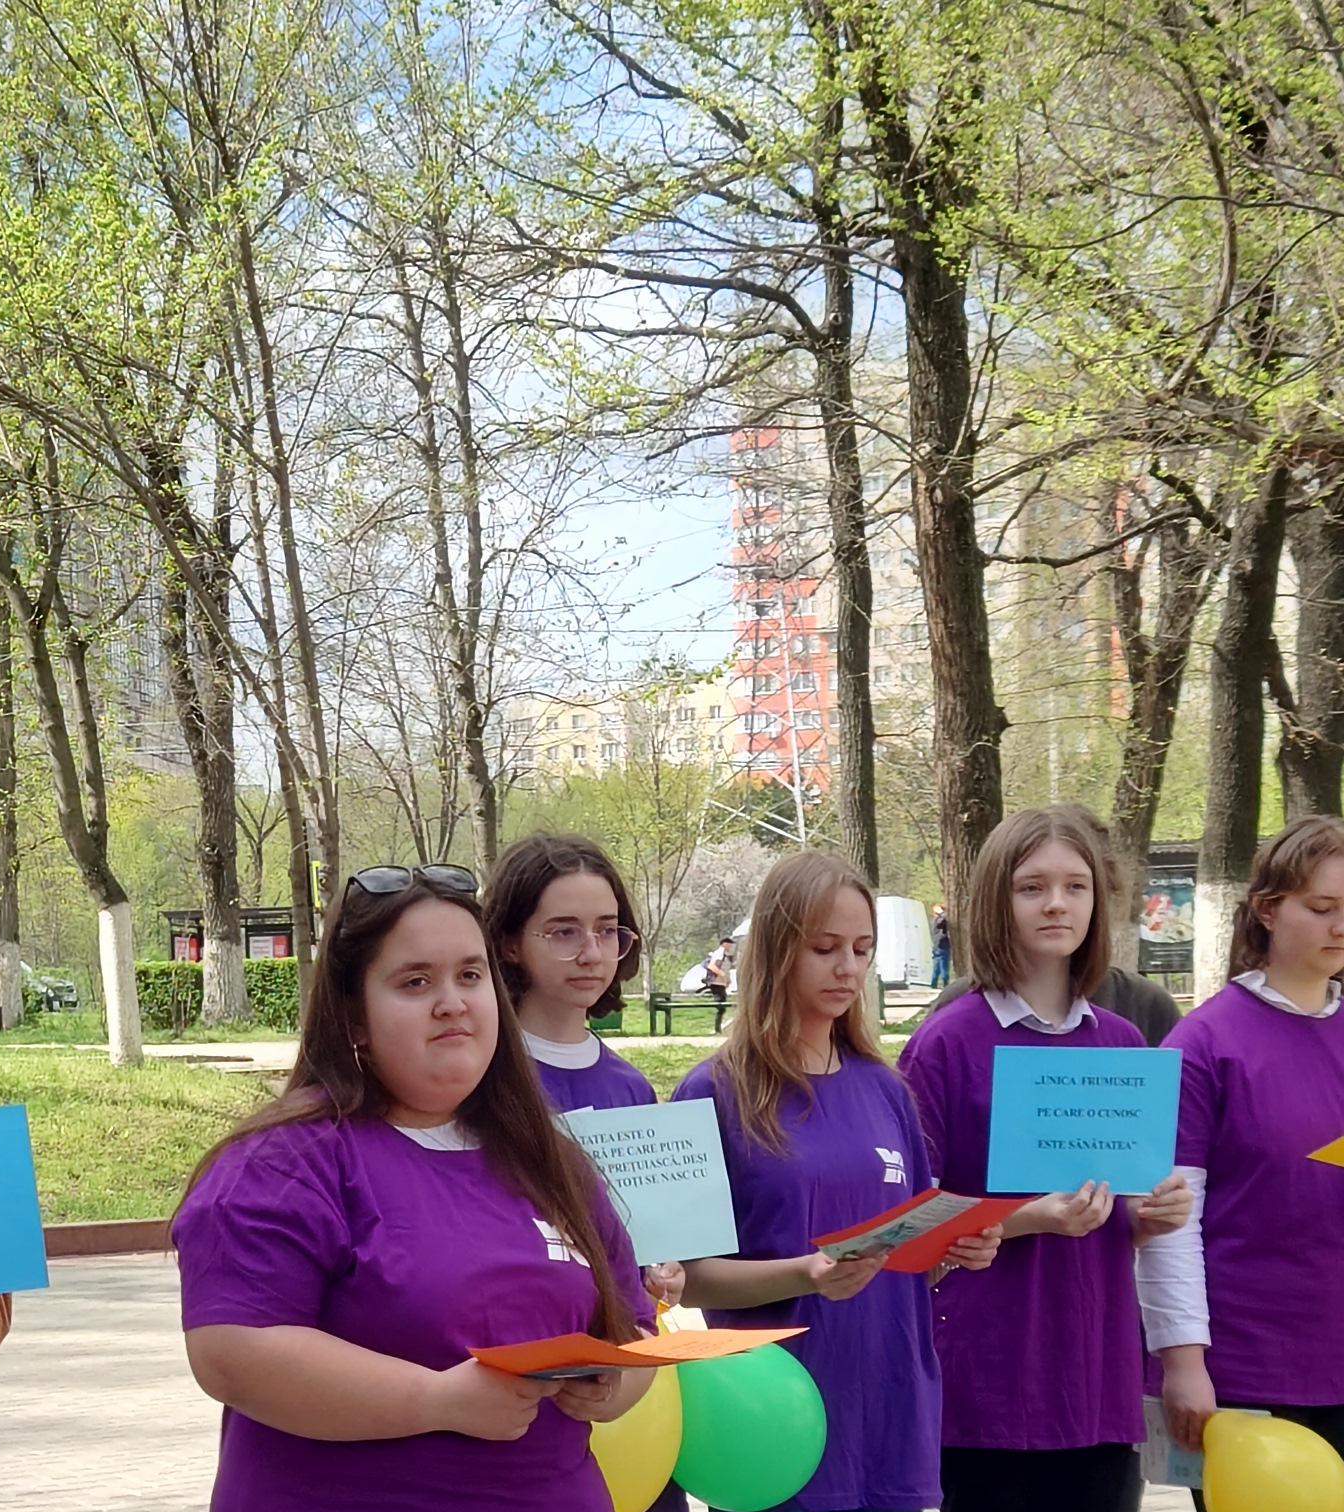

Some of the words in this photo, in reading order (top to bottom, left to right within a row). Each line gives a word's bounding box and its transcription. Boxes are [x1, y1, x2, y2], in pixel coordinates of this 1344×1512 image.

[1037, 1108, 1052, 1117] PE
[1054, 1108, 1085, 1117] CARE
[1088, 1108, 1096, 1117] O
[1098, 1108, 1142, 1118] CUNOSC
[617, 1130, 644, 1141] ESTE
[647, 1129, 655, 1138] O
[1038, 1139, 1065, 1148] ESTE
[611, 1147, 625, 1158] PE
[627, 1144, 657, 1156] CARE
[645, 1175, 658, 1185] SE
[661, 1171, 690, 1182] NASC
[693, 1168, 708, 1178] CU
